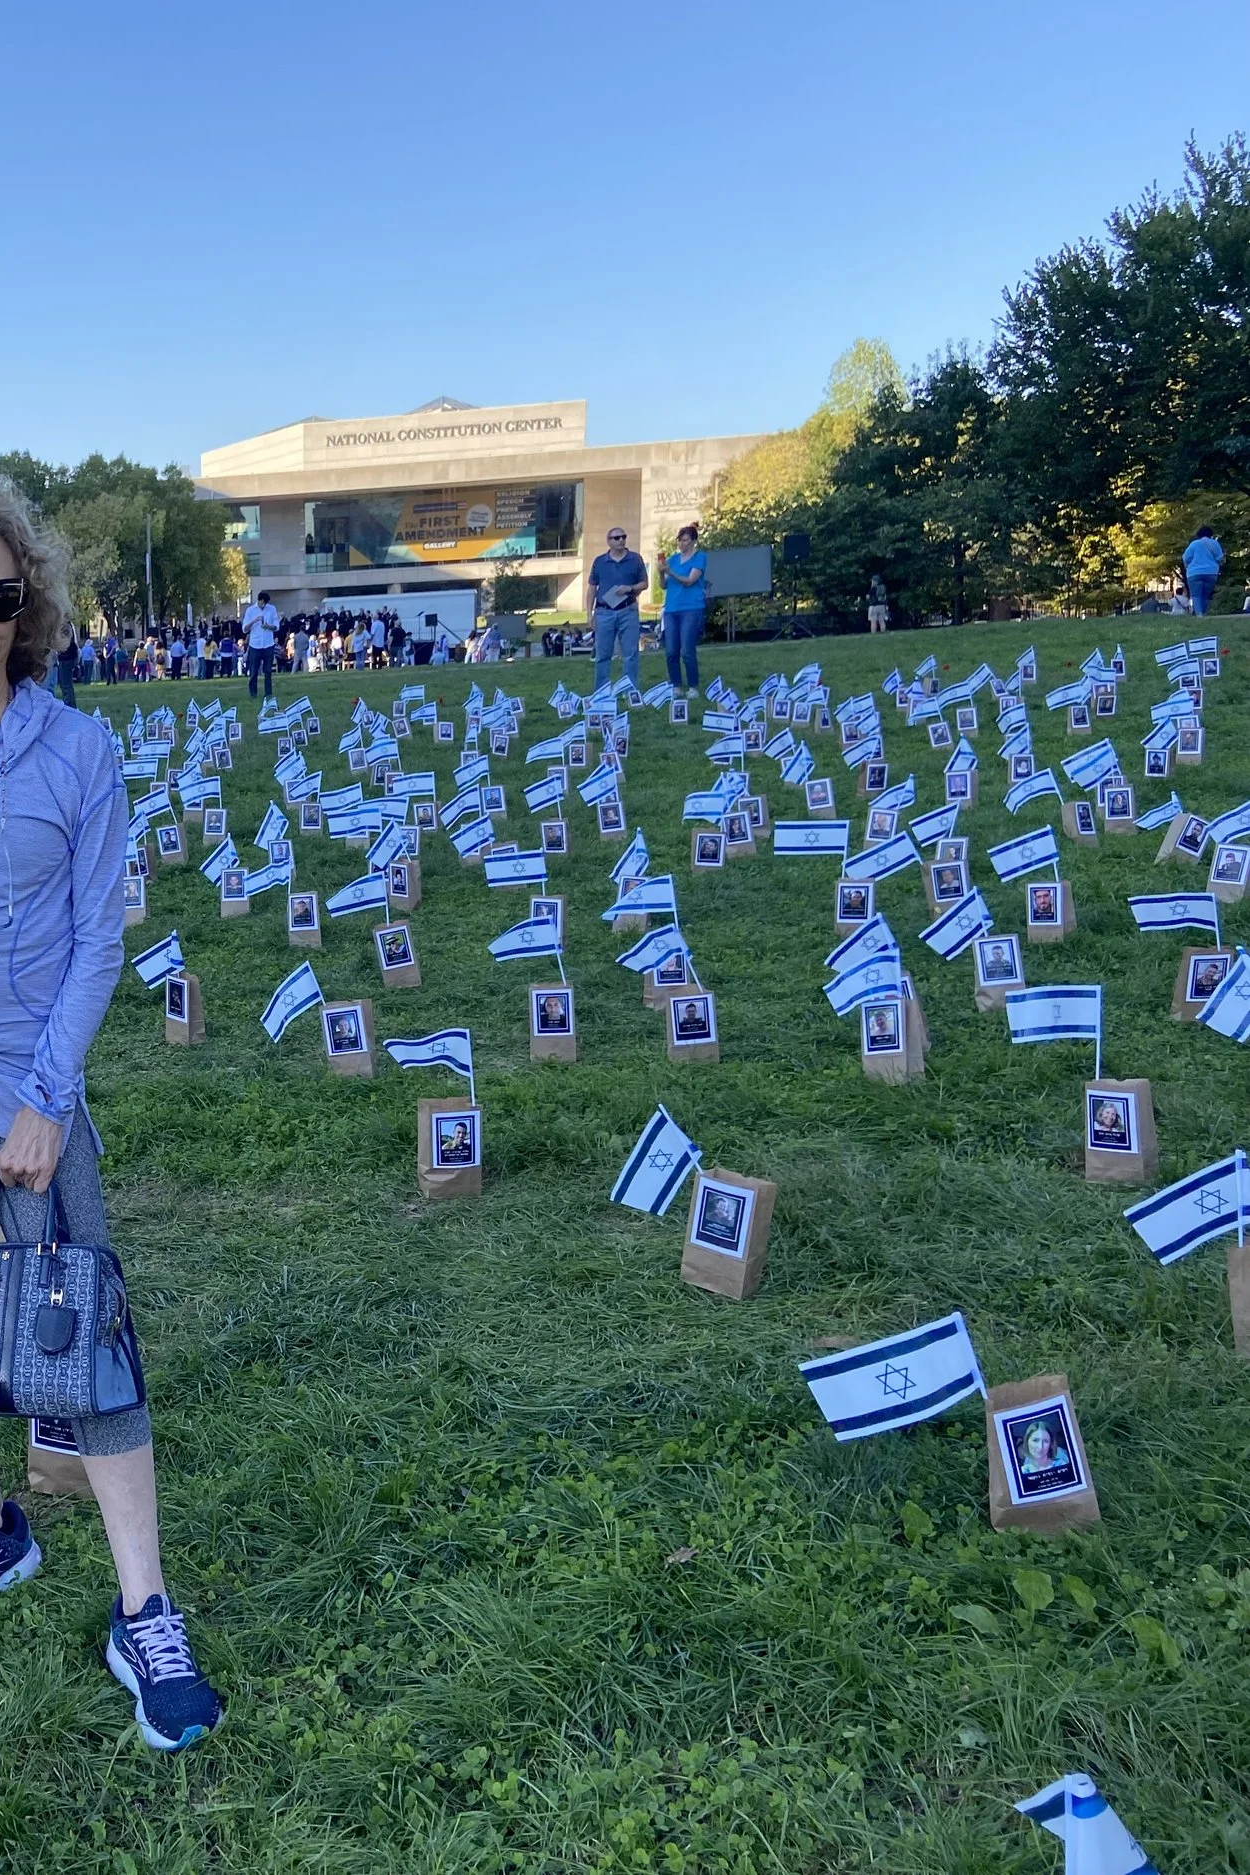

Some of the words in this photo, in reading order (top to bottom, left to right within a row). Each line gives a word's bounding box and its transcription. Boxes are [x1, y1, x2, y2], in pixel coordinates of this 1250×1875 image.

[326, 431, 395, 447] NATIONAL
[398, 422, 502, 441] CONSTITUTION
[505, 417, 563, 433] CENTER
[419, 515, 461, 528] FIRST
[496, 512, 532, 520] ASSEMBLY
[496, 521, 528, 529] PETITION
[395, 526, 486, 541] AMENDMENT
[423, 541, 456, 550] GALLERY
